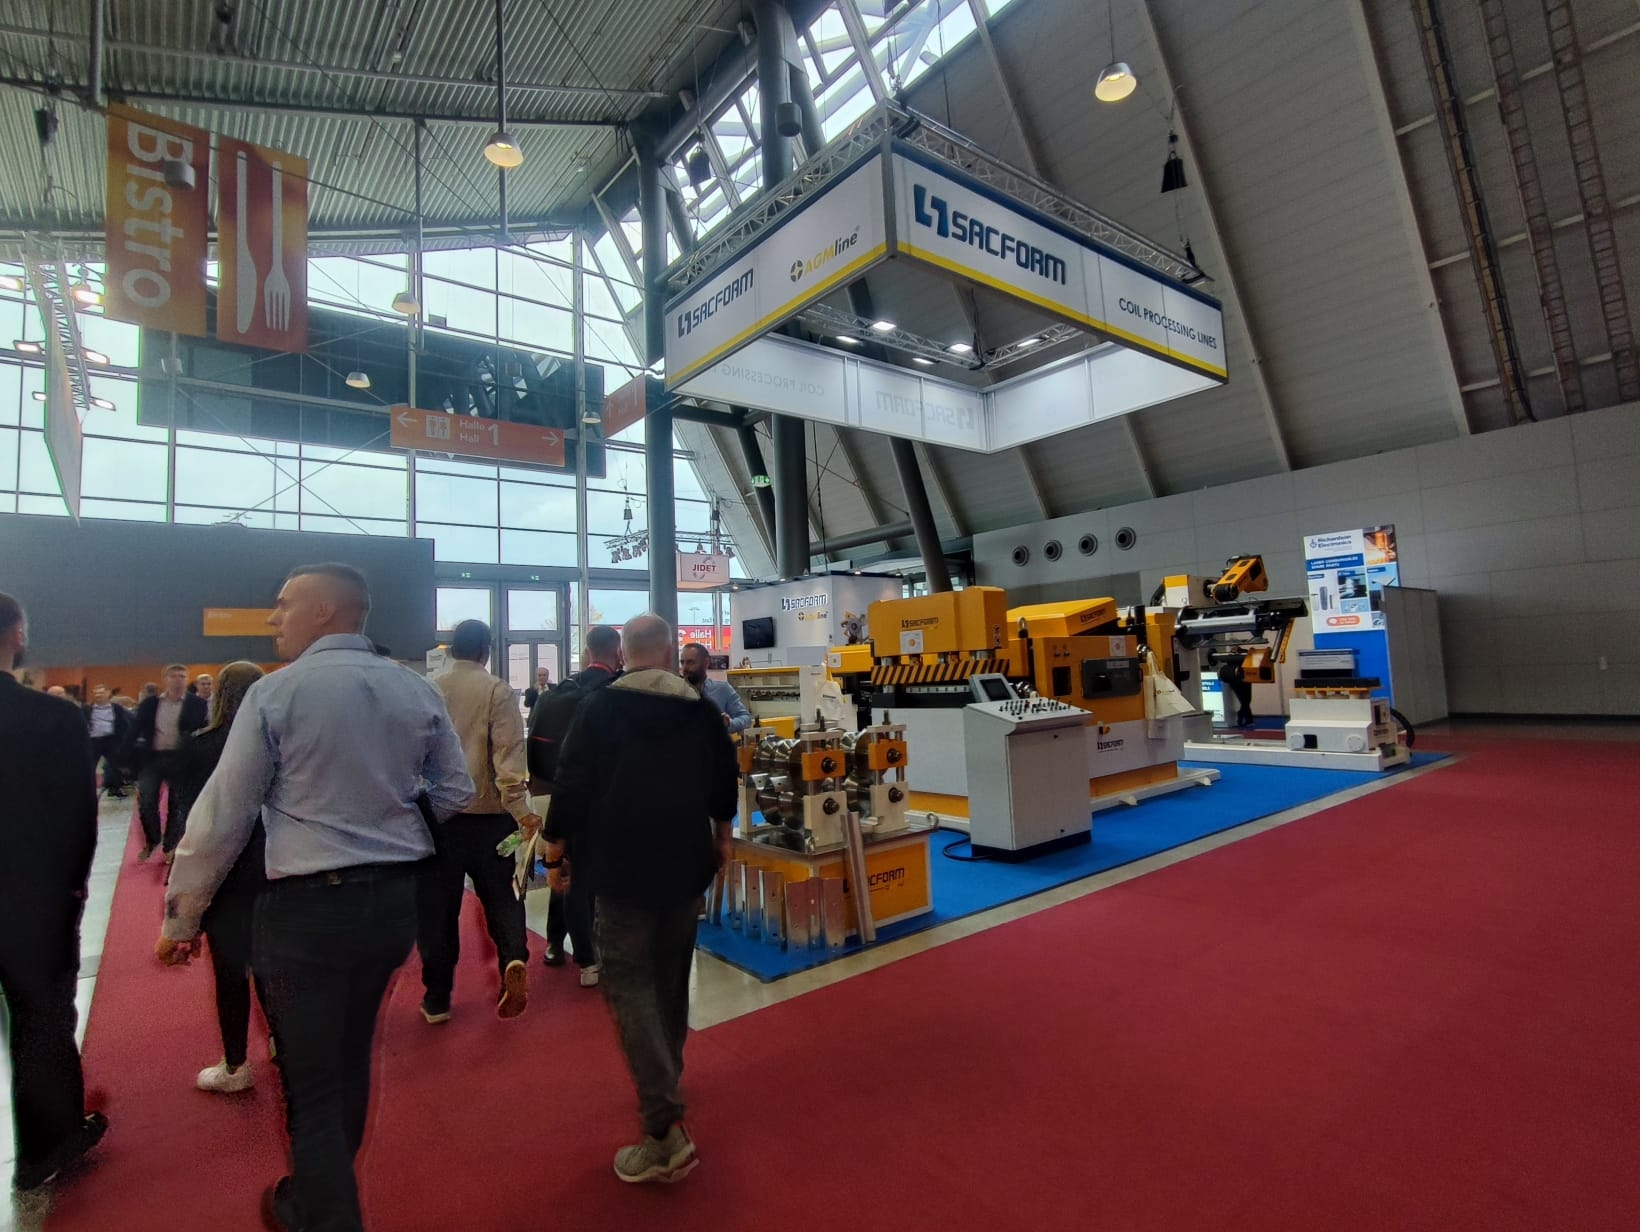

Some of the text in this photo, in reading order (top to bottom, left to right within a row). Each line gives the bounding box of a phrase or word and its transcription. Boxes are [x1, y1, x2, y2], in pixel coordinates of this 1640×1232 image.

[122, 121, 194, 308] Bistro
[803, 231, 858, 277] AGMline
[951, 210, 1067, 286] SACFORM
[692, 267, 754, 329] SACFORM
[1118, 298, 1217, 349] COIL PROCESSING LINES
[459, 419, 499, 446] Halle 1
[459, 433, 480, 443] Hall
[692, 564, 717, 572] JIDET
[791, 594, 828, 608] SACFORM
[867, 867, 905, 886] CFORM
